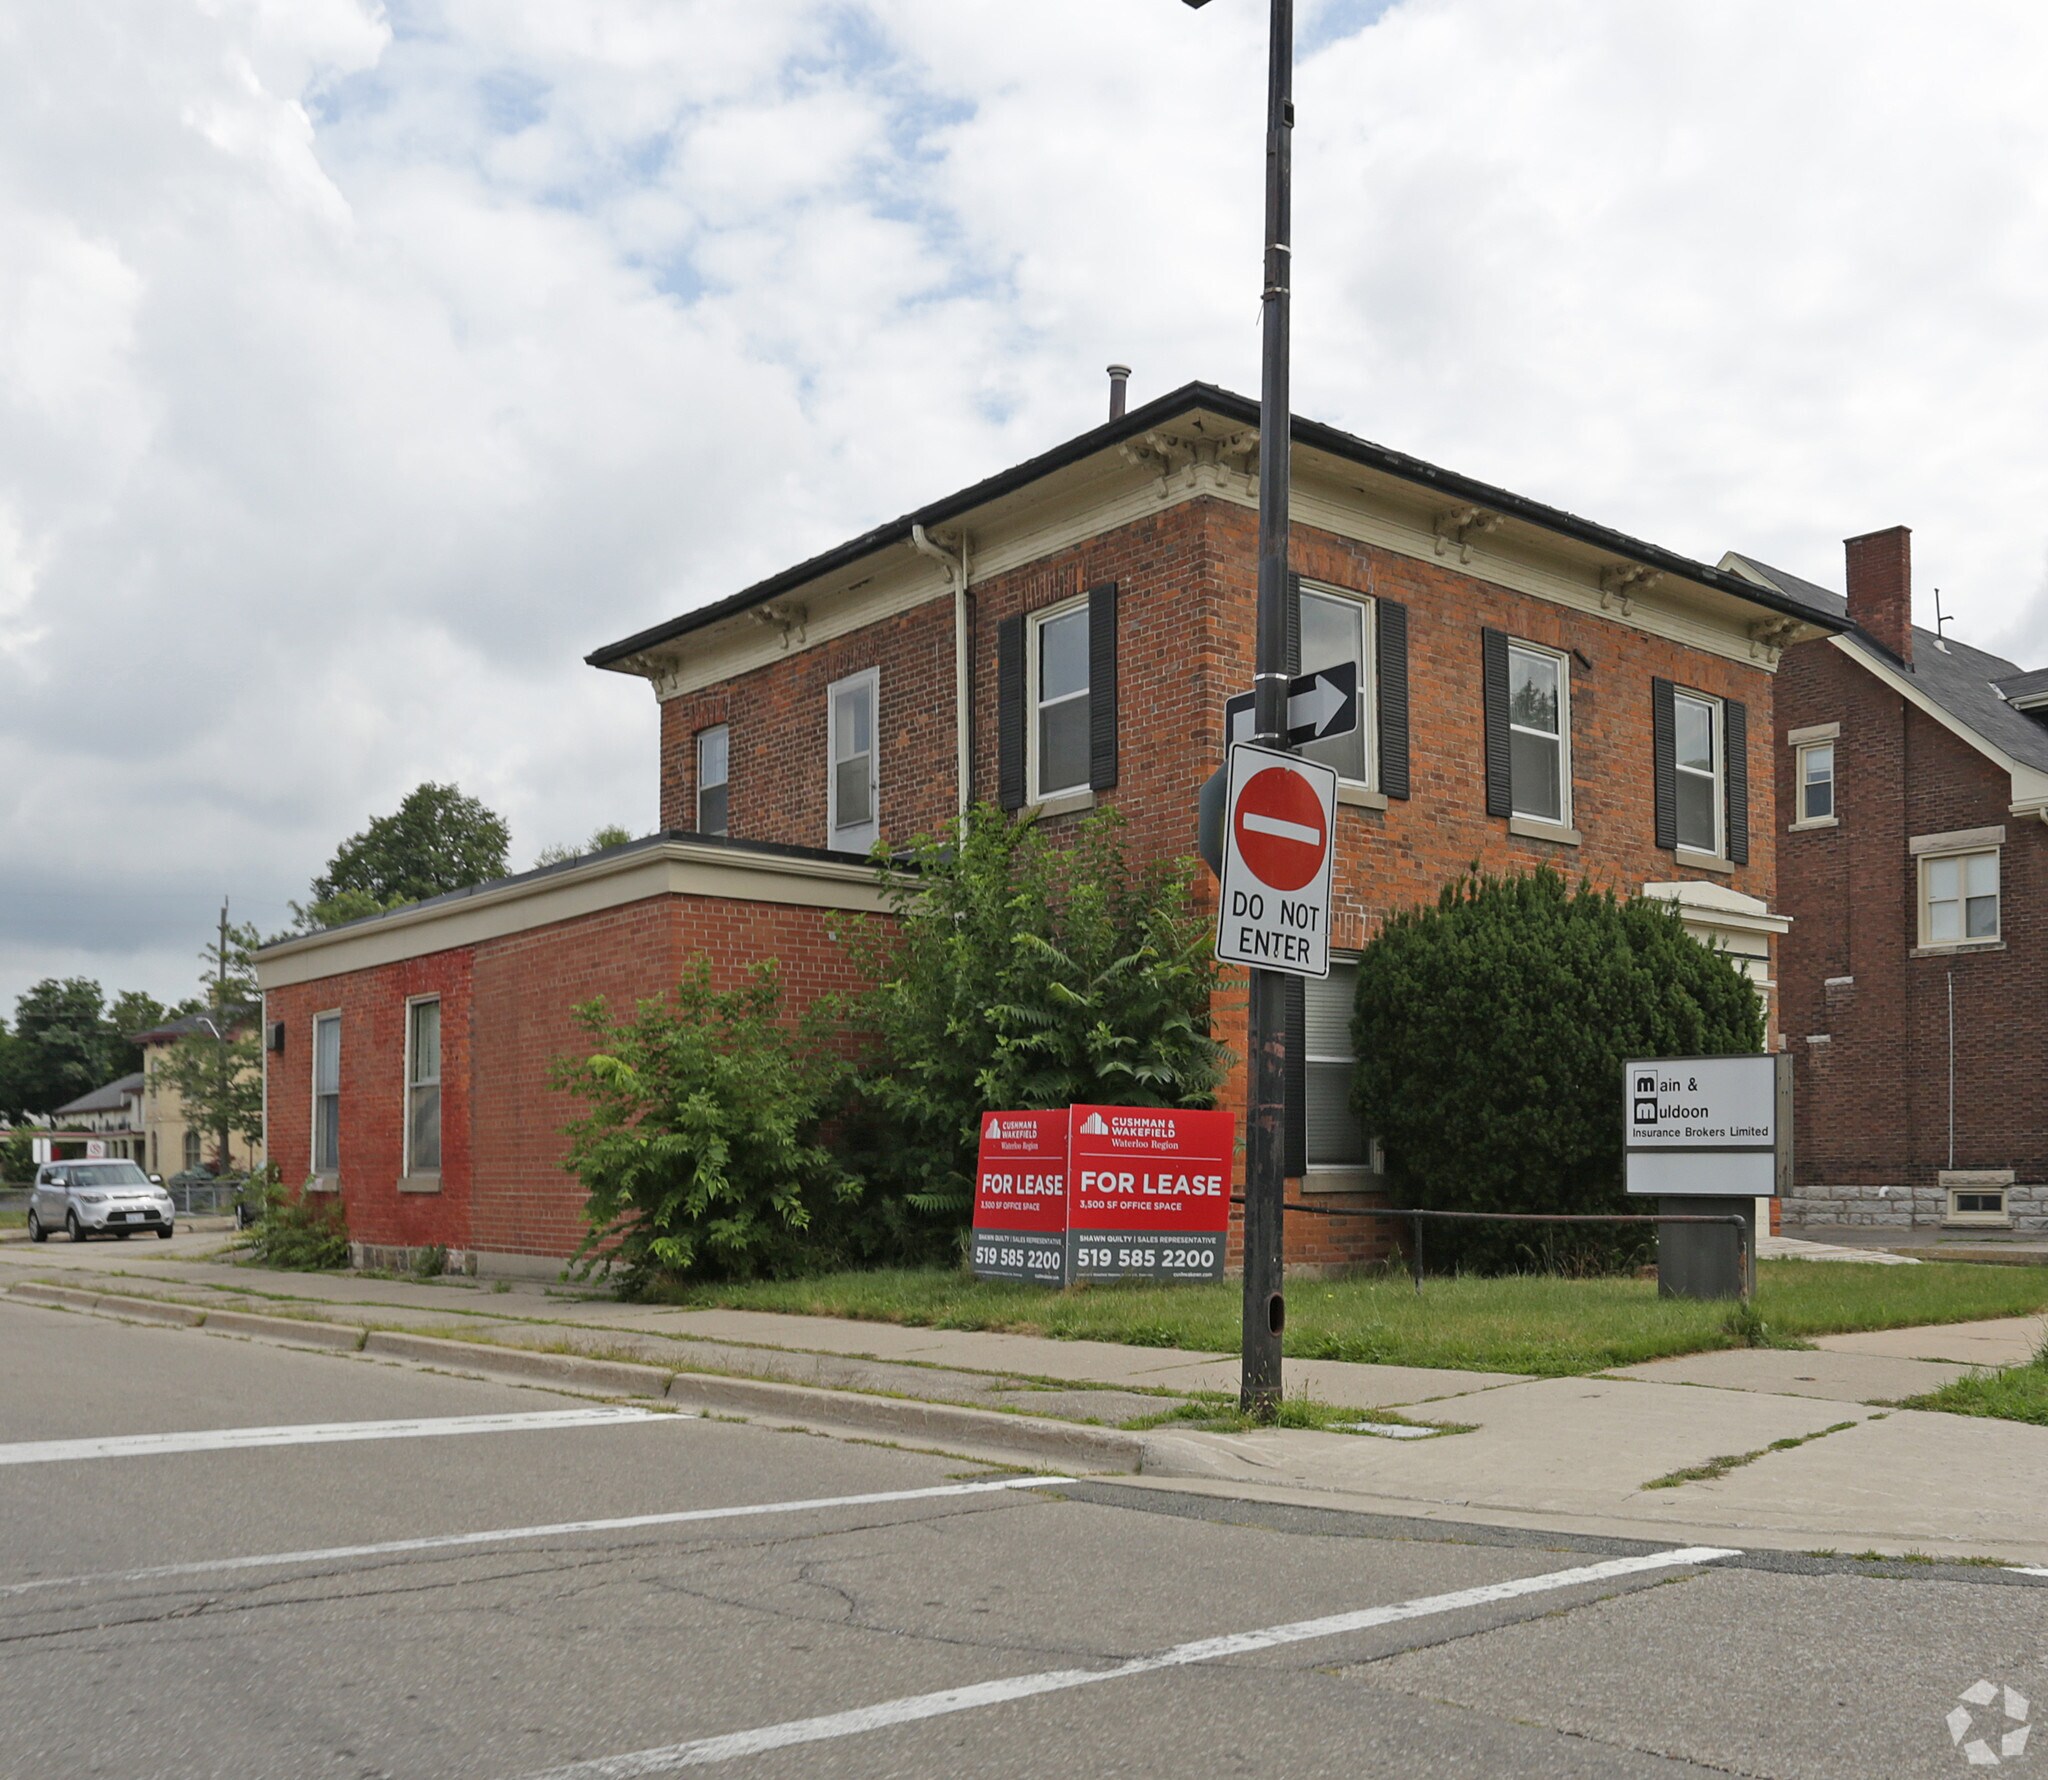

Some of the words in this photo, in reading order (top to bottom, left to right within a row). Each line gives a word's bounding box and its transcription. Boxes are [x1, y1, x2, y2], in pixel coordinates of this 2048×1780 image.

[1232, 890, 1264, 920] DO
[1280, 900, 1320, 931] NOT
[1239, 926, 1311, 964] ENTER
[1687, 1077, 1698, 1092] &
[1002, 1121, 1032, 1130] CUSHMAN
[1032, 1120, 1038, 1130] &
[1111, 1117, 1166, 1128] CUSHMAN
[1167, 1119, 1175, 1129] &
[1002, 1129, 1038, 1139] WAKEFIELD
[1111, 1126, 1176, 1138] WAKEFIELD
[1632, 1127, 1681, 1138] Insurance
[1685, 1126, 1726, 1137] Brokers
[1730, 1126, 1769, 1137] Limited
[1001, 1141, 1021, 1150] Waterloo
[1022, 1142, 1039, 1151] Region
[1111, 1138, 1149, 1148] Waterloo
[1150, 1140, 1179, 1150] Region
[982, 1173, 1013, 1195] FOR
[1016, 1174, 1063, 1196] LEASE
[1081, 1171, 1135, 1194] FOR
[1143, 1173, 1222, 1196] LEASE
[1003, 1201, 1022, 1210] OFFICE
[1022, 1202, 1040, 1211] SPACE
[1079, 1200, 1105, 1209] 3,500
[1106, 1200, 1118, 1209] SF
[1120, 1201, 1152, 1210] OFFICE
[1153, 1202, 1182, 1211] SPACE
[1079, 1235, 1106, 1243] SHAWN
[1106, 1235, 1133, 1243] QUILTY
[1159, 1236, 1216, 1244] REPRESENTATIVE
[975, 1246, 998, 1265] 519
[1000, 1248, 1024, 1267] 585
[1027, 1250, 1061, 1270] 2200
[1077, 1248, 1112, 1267] 519
[1117, 1249, 1156, 1267] 585
[1161, 1250, 1214, 1268] 2200
